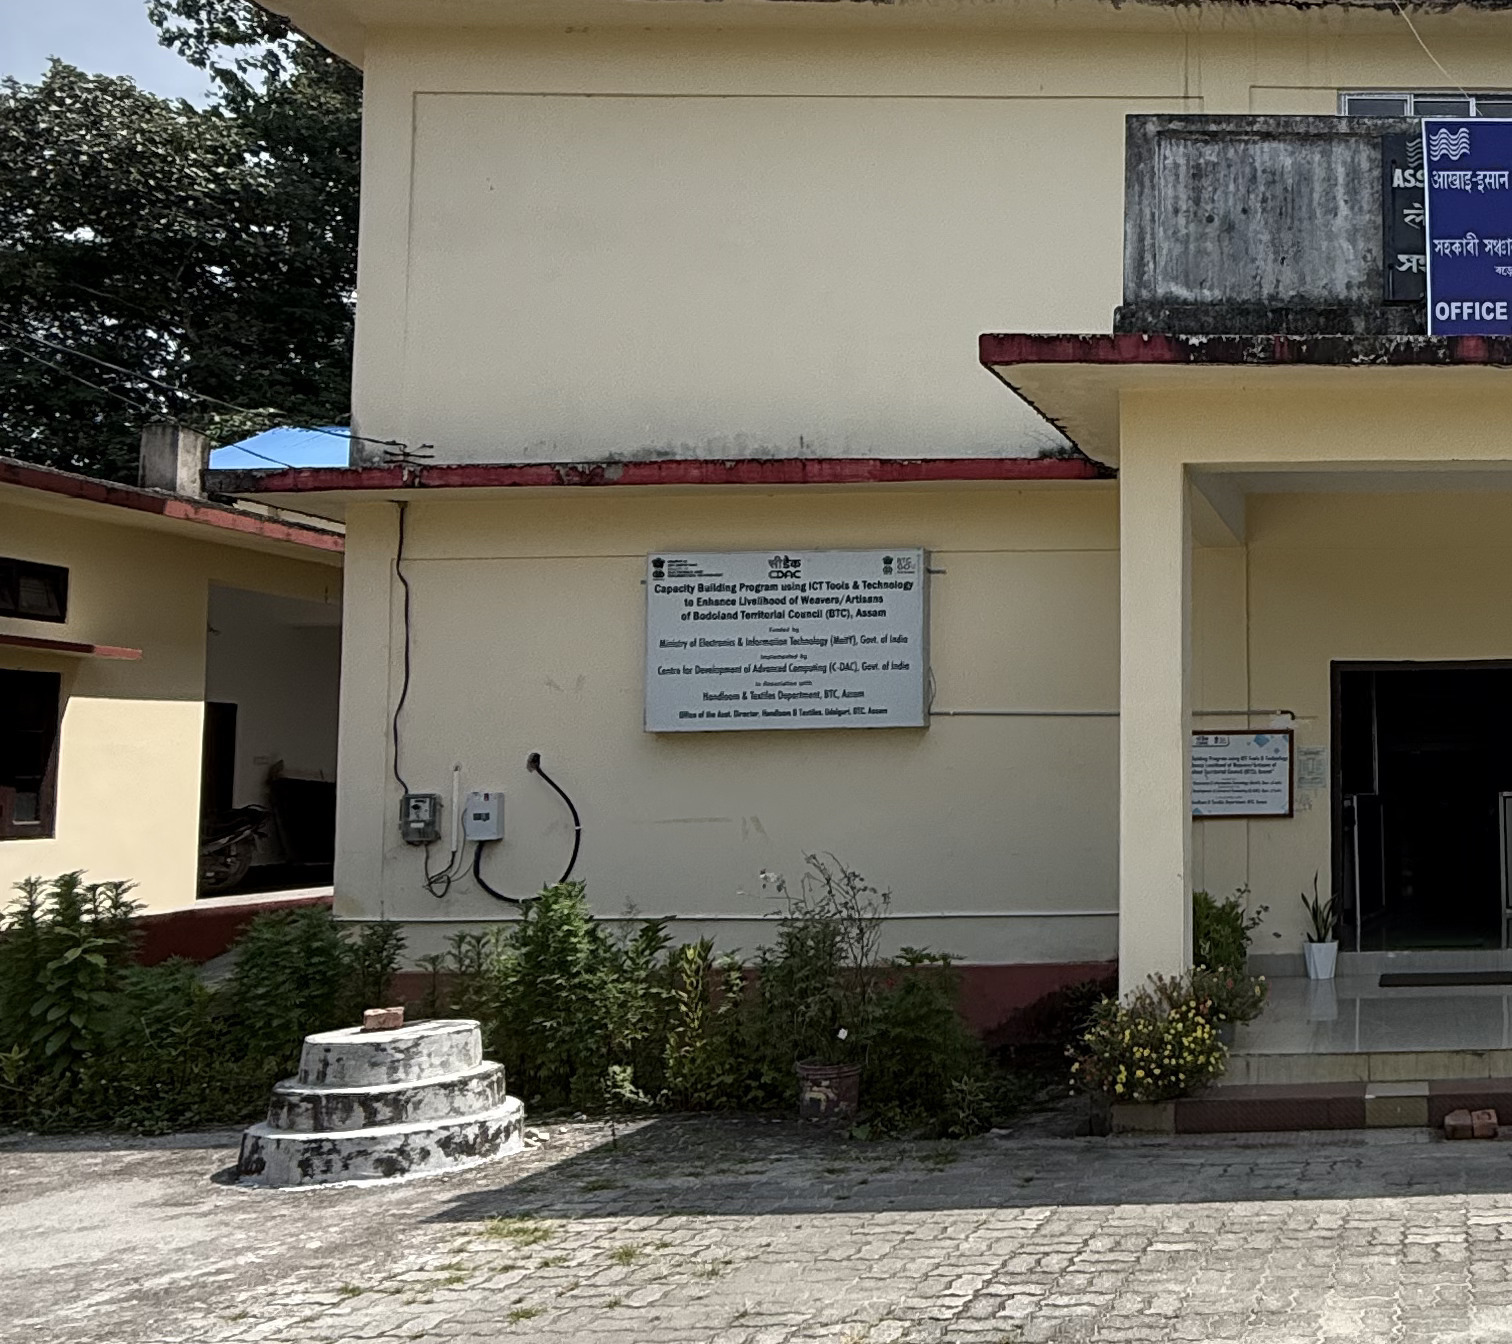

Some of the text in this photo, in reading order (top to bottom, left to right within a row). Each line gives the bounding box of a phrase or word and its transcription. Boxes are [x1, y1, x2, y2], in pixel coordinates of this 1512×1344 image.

[1435, 302, 1507, 320] OFFICE
[655, 580, 914, 594] Capacity Building Program using ICT Tools & Technology
[684, 595, 884, 607] to Enhance Livelihood of Weavers/Artisans
[681, 612, 691, 621] of
[693, 611, 739, 620] Bodoland
[741, 610, 785, 619] Territorial
[788, 609, 822, 619] Council
[856, 609, 887, 618] Assam
